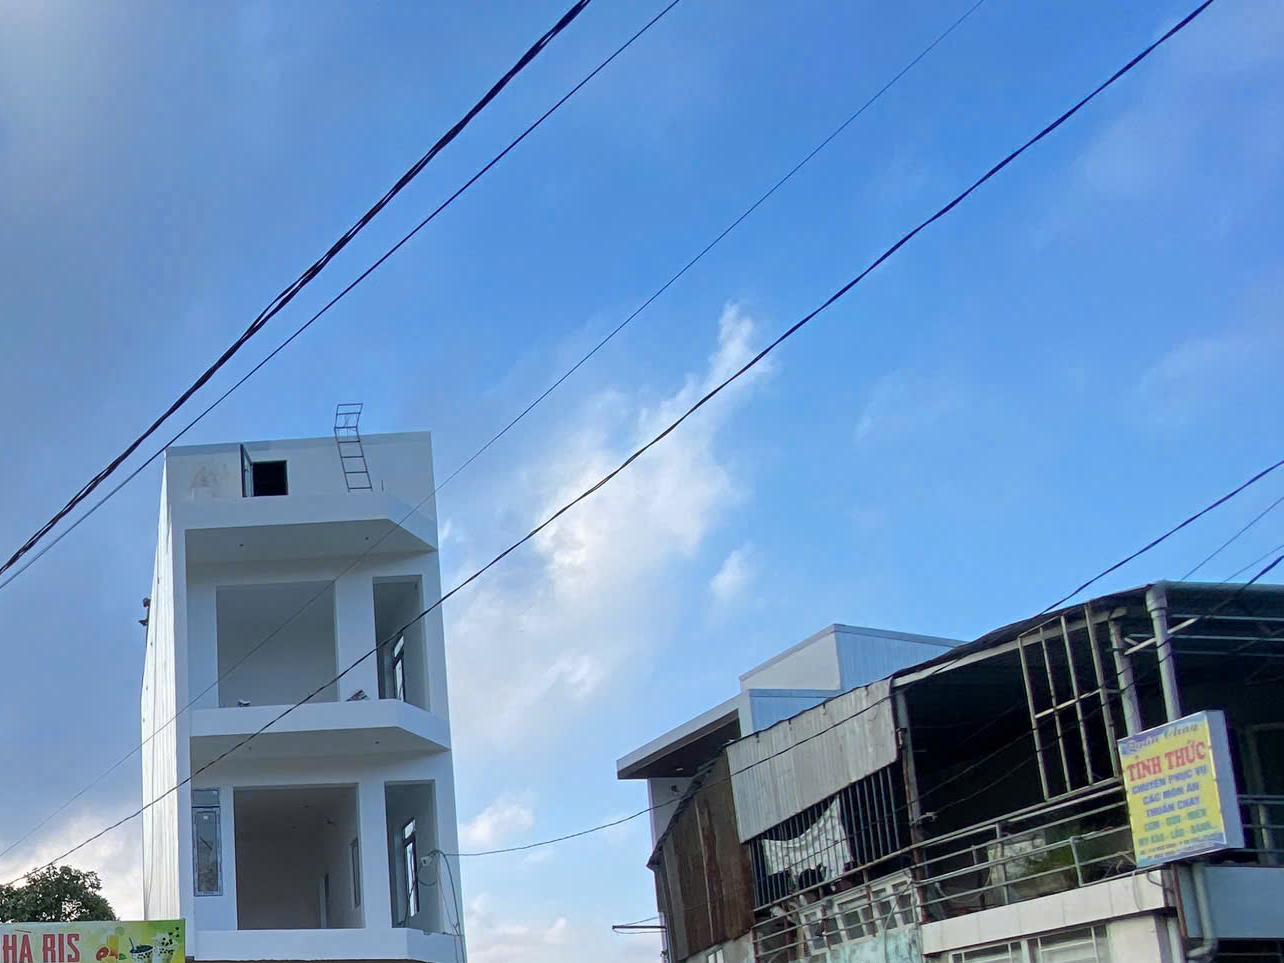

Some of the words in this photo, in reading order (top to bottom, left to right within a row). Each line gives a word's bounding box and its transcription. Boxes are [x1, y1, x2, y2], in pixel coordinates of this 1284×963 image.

[1127, 755, 1162, 782] TỈNH
[1165, 740, 1206, 770] THỨC
[42, 933, 81, 963] RIS
